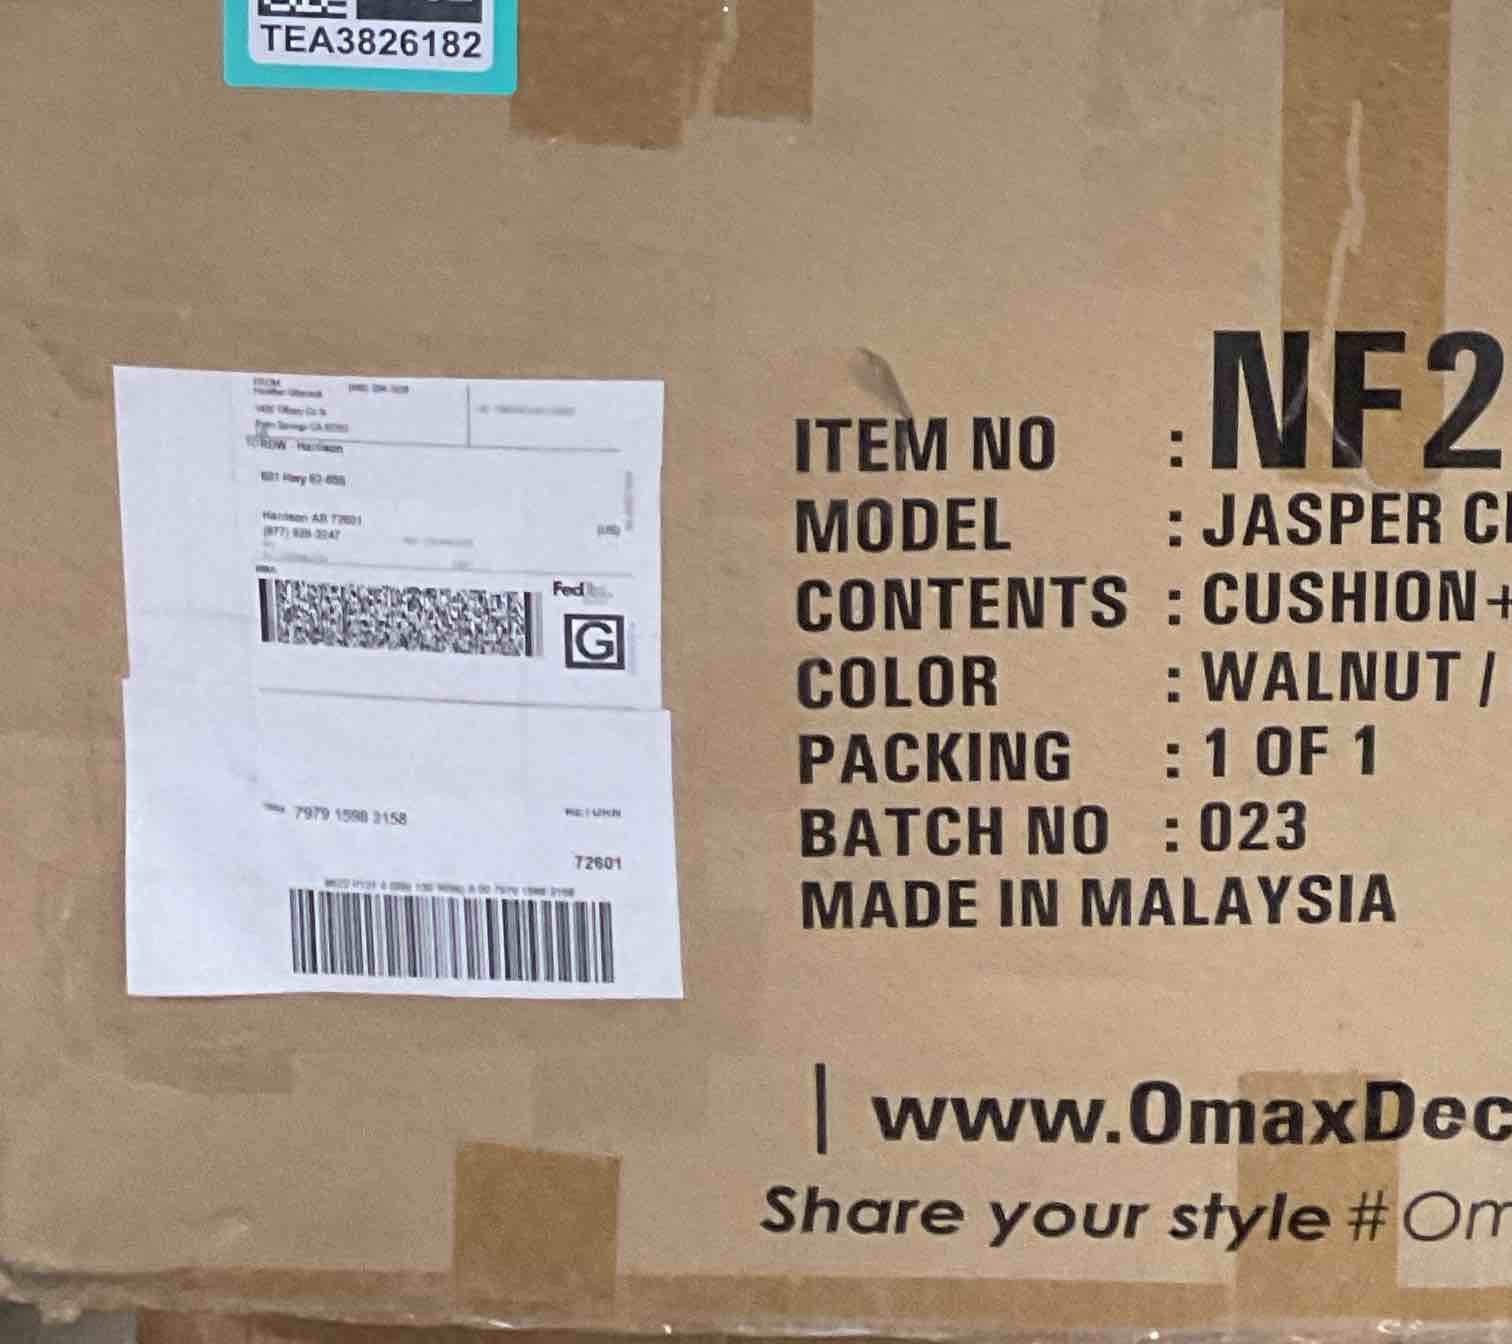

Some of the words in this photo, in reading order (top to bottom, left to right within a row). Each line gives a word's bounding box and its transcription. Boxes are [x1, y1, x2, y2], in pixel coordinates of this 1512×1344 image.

[260, 24, 482, 59] TEA3826182
[795, 417, 948, 472] ITEM
[972, 416, 1056, 472] NO
[796, 497, 1012, 553] MODEL
[1203, 492, 1442, 547] JASPER
[796, 576, 1128, 633] CONTENTS
[575, 620, 614, 662] G
[797, 655, 998, 710] COLOR
[1201, 650, 1461, 703] WALNUT
[799, 730, 1072, 785] PACKING
[1205, 728, 1226, 779] 1
[1256, 726, 1329, 777] OF
[1354, 725, 1376, 776] 1
[296, 805, 330, 821] 7979
[800, 806, 1003, 858] BATCH
[1027, 805, 1109, 856] NO
[1201, 801, 1308, 852] 023
[574, 855, 622, 871] 72601
[801, 878, 978, 930] MADE
[1000, 878, 1059, 928] IN
[1081, 874, 1398, 928] MALAYSIA
[760, 1184, 964, 1236] Share
[988, 1200, 1150, 1249] your
[1169, 1192, 1331, 1252] style
